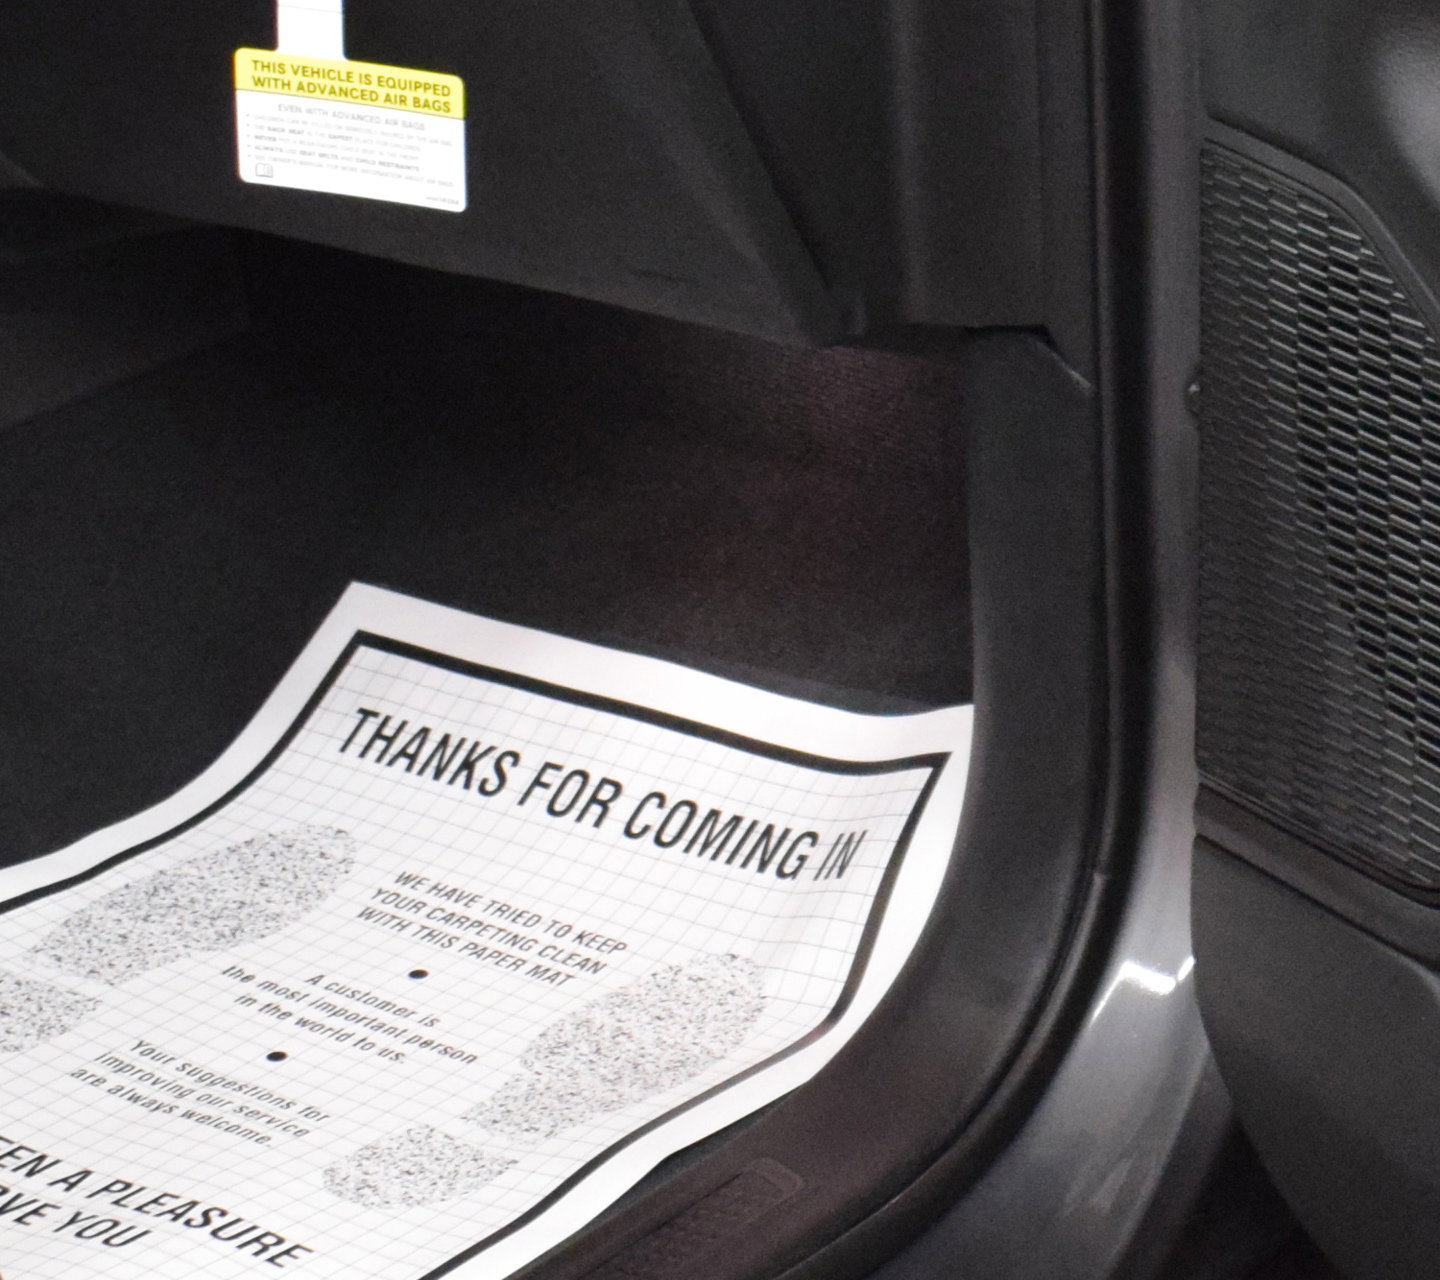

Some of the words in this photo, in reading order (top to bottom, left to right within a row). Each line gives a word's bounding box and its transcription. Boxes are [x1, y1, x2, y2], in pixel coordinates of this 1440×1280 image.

[251, 59, 286, 75] THIS
[291, 64, 354, 83] VEHICLE
[358, 72, 373, 86] IS
[377, 75, 451, 98] EQUIPPED
[251, 75, 291, 91] WITH
[296, 78, 379, 103] ADVANCED
[383, 92, 408, 107] AIR
[412, 96, 452, 113] BAGS
[278, 103, 302, 114] EVEN
[305, 107, 329, 117] WITH
[332, 109, 381, 125] ADVANCED
[340, 707, 520, 797] THANKS
[517, 762, 624, 829] FOR
[624, 791, 819, 881] COMING
[813, 830, 868, 882] IN
[357, 906, 412, 933] WITH
[413, 924, 461, 949] THIS
[459, 941, 528, 972] PAPER
[525, 964, 577, 987] MAT
[371, 887, 427, 914] YOUR
[427, 907, 539, 952] CARPETING
[538, 945, 608, 975] CLEAN
[394, 871, 430, 892] WE
[427, 881, 483, 909] HAVE
[482, 899, 543, 928] TRIED
[543, 919, 574, 938] TO
[573, 930, 629, 955] KEEP
[221, 965, 256, 983] the
[258, 979, 310, 1002] most
[310, 996, 410, 1039] important
[402, 1032, 479, 1064] person
[234, 993, 258, 1007] in
[258, 1001, 293, 1021] the
[294, 1016, 356, 1043] world
[352, 1036, 376, 1052] to
[377, 1046, 408, 1064] us.
[304, 974, 325, 986] A
[324, 982, 419, 1019] customer
[417, 1014, 441, 1029] is
[69, 1067, 108, 1088] are
[106, 1083, 182, 1115] always
[179, 1108, 273, 1148] welcome.
[94, 1051, 195, 1100] improving
[196, 1092, 234, 1109] our
[233, 1103, 312, 1138] service
[129, 1039, 178, 1065] Your
[175, 1060, 298, 1111] suggestions
[297, 1105, 332, 1123] for
[47, 1167, 95, 1193] A
[87, 1177, 316, 1268] PLEASURE
[52, 1210, 153, 1249] YOU
